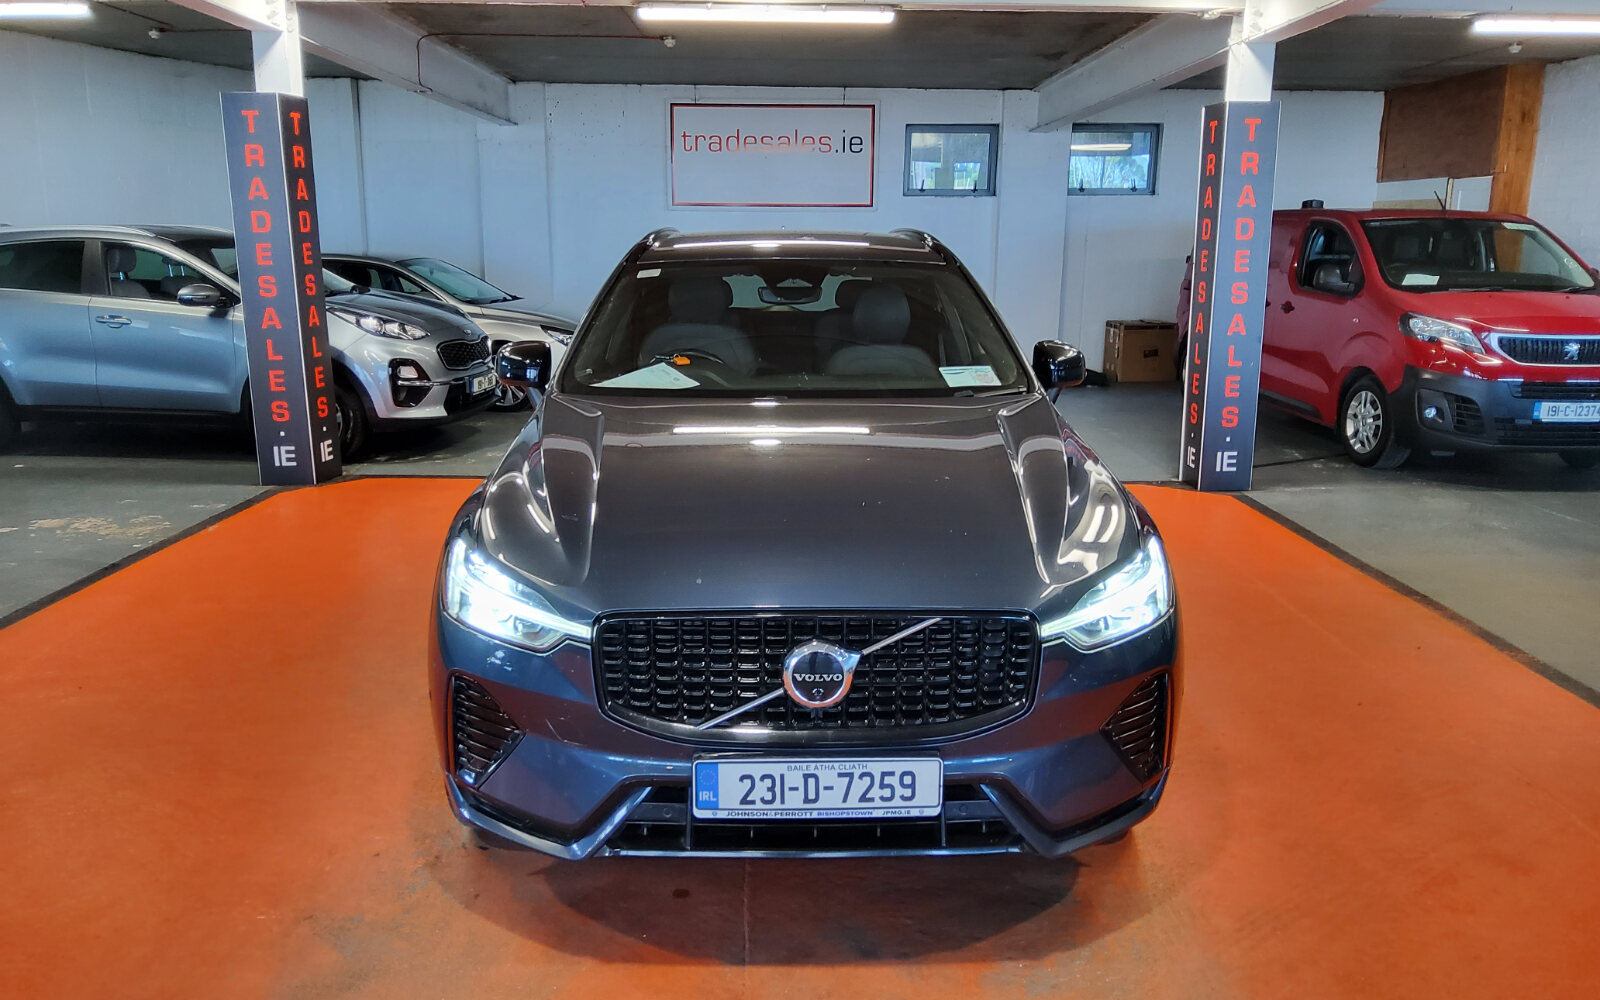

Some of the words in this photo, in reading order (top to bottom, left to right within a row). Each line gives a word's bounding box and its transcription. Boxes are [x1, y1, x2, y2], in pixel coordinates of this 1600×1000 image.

[680, 128, 864, 153] tradesales.ie
[793, 673, 843, 682] VOLVO
[838, 763, 868, 771] CLIATH
[738, 770, 917, 806] 231-D-7259
[699, 790, 717, 802] IRL
